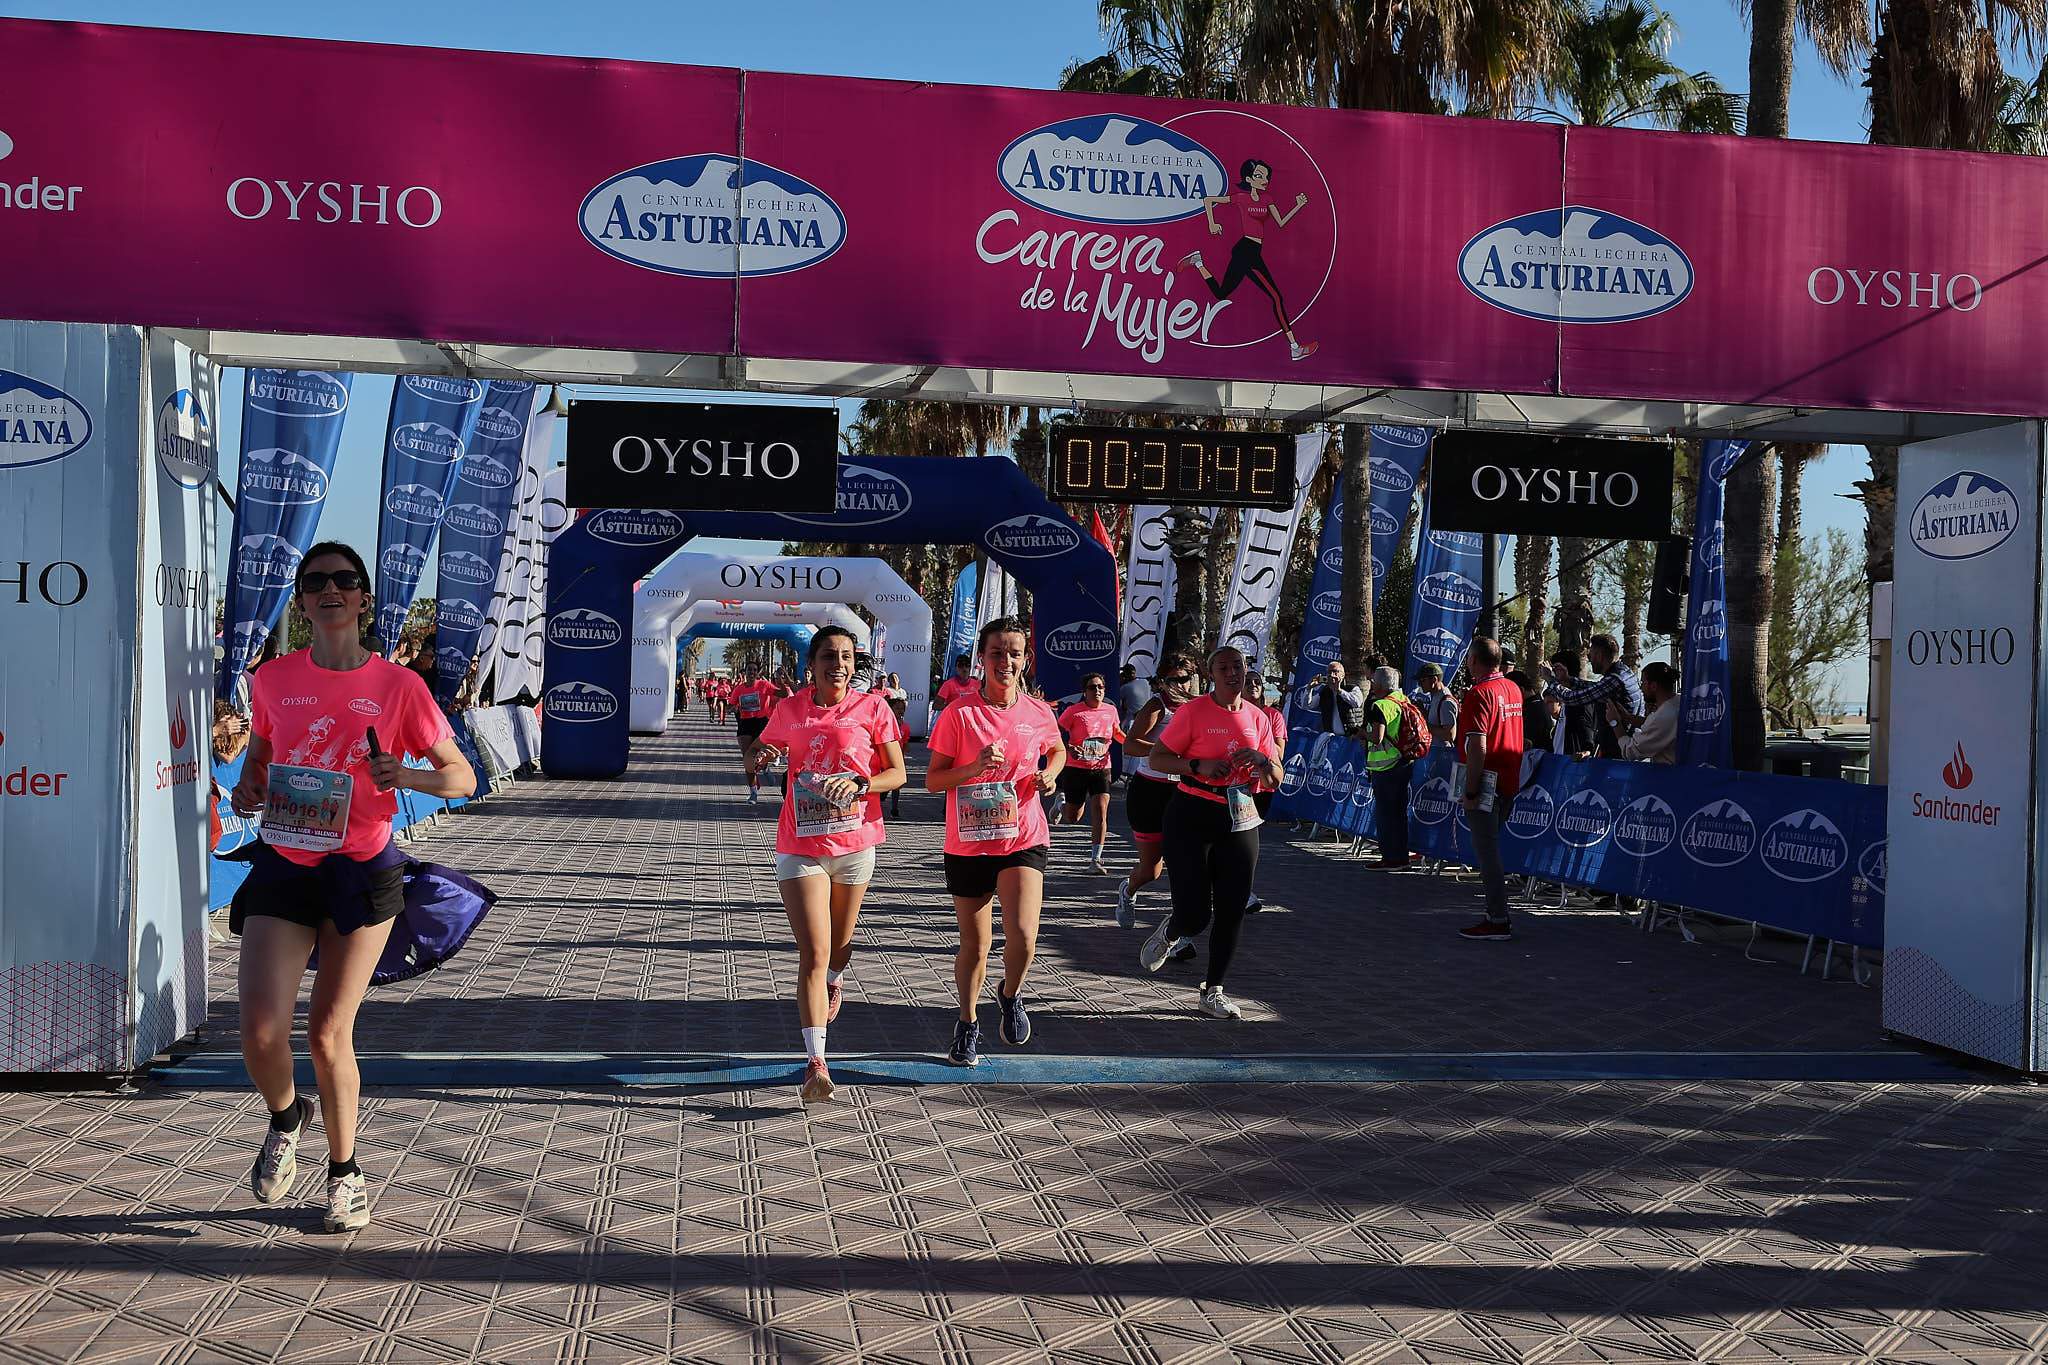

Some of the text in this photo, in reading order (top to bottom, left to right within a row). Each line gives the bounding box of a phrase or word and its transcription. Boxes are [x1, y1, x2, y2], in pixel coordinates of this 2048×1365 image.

[1052, 148, 1203, 168] CENTRAL LECHERA
[1015, 148, 1207, 199] ASTURIANA
[226, 176, 441, 228] OYSHO
[642, 193, 724, 208] CENTRAL
[599, 194, 825, 248] ASTURIANA
[976, 209, 1163, 273] Carrera
[1513, 243, 1669, 262] CENTRAL LECHERA
[1476, 245, 1675, 297] ASTURIANA
[1808, 266, 1983, 312] OYSHO
[1020, 271, 1232, 363] de la Mujer
[0, 403, 67, 415] ECHERA
[161, 417, 209, 468] ASTURIANA
[612, 436, 800, 480] OYSHO
[1067, 439, 1276, 494] 00:37:42
[246, 472, 320, 497] STURIANA
[847, 482, 895, 490] LECHERA
[1472, 465, 1638, 507] OYSHO
[1932, 497, 2006, 514] CENTRAL LECHERA
[446, 511, 498, 534] ASTURIANA
[592, 517, 675, 536] ASTURIANA
[1916, 508, 2009, 540] ASTURIANA
[993, 531, 1074, 547] ASTURIANA
[156, 564, 208, 610] OYSHO
[721, 564, 842, 591] OYSHO
[647, 589, 684, 598] OYSHO
[876, 593, 911, 602] OYSHO
[551, 623, 616, 641] ASTURIANA
[1050, 637, 1113, 651] ASTURIANA
[893, 644, 926, 654] OYSHO
[1907, 627, 2015, 666] OYSHO
[282, 696, 317, 706] OYSHO
[547, 695, 612, 713] ASTURIANA
[0, 766, 67, 796] der
[1558, 808, 1606, 835] ASTURIANA
[1912, 793, 2000, 827] Santander
[314, 828, 339, 838] VALENCIA
[1617, 815, 1669, 843] ASTURIANA
[1684, 821, 1748, 852] ASTURIANA
[1764, 831, 1836, 868] ASTURIANA
